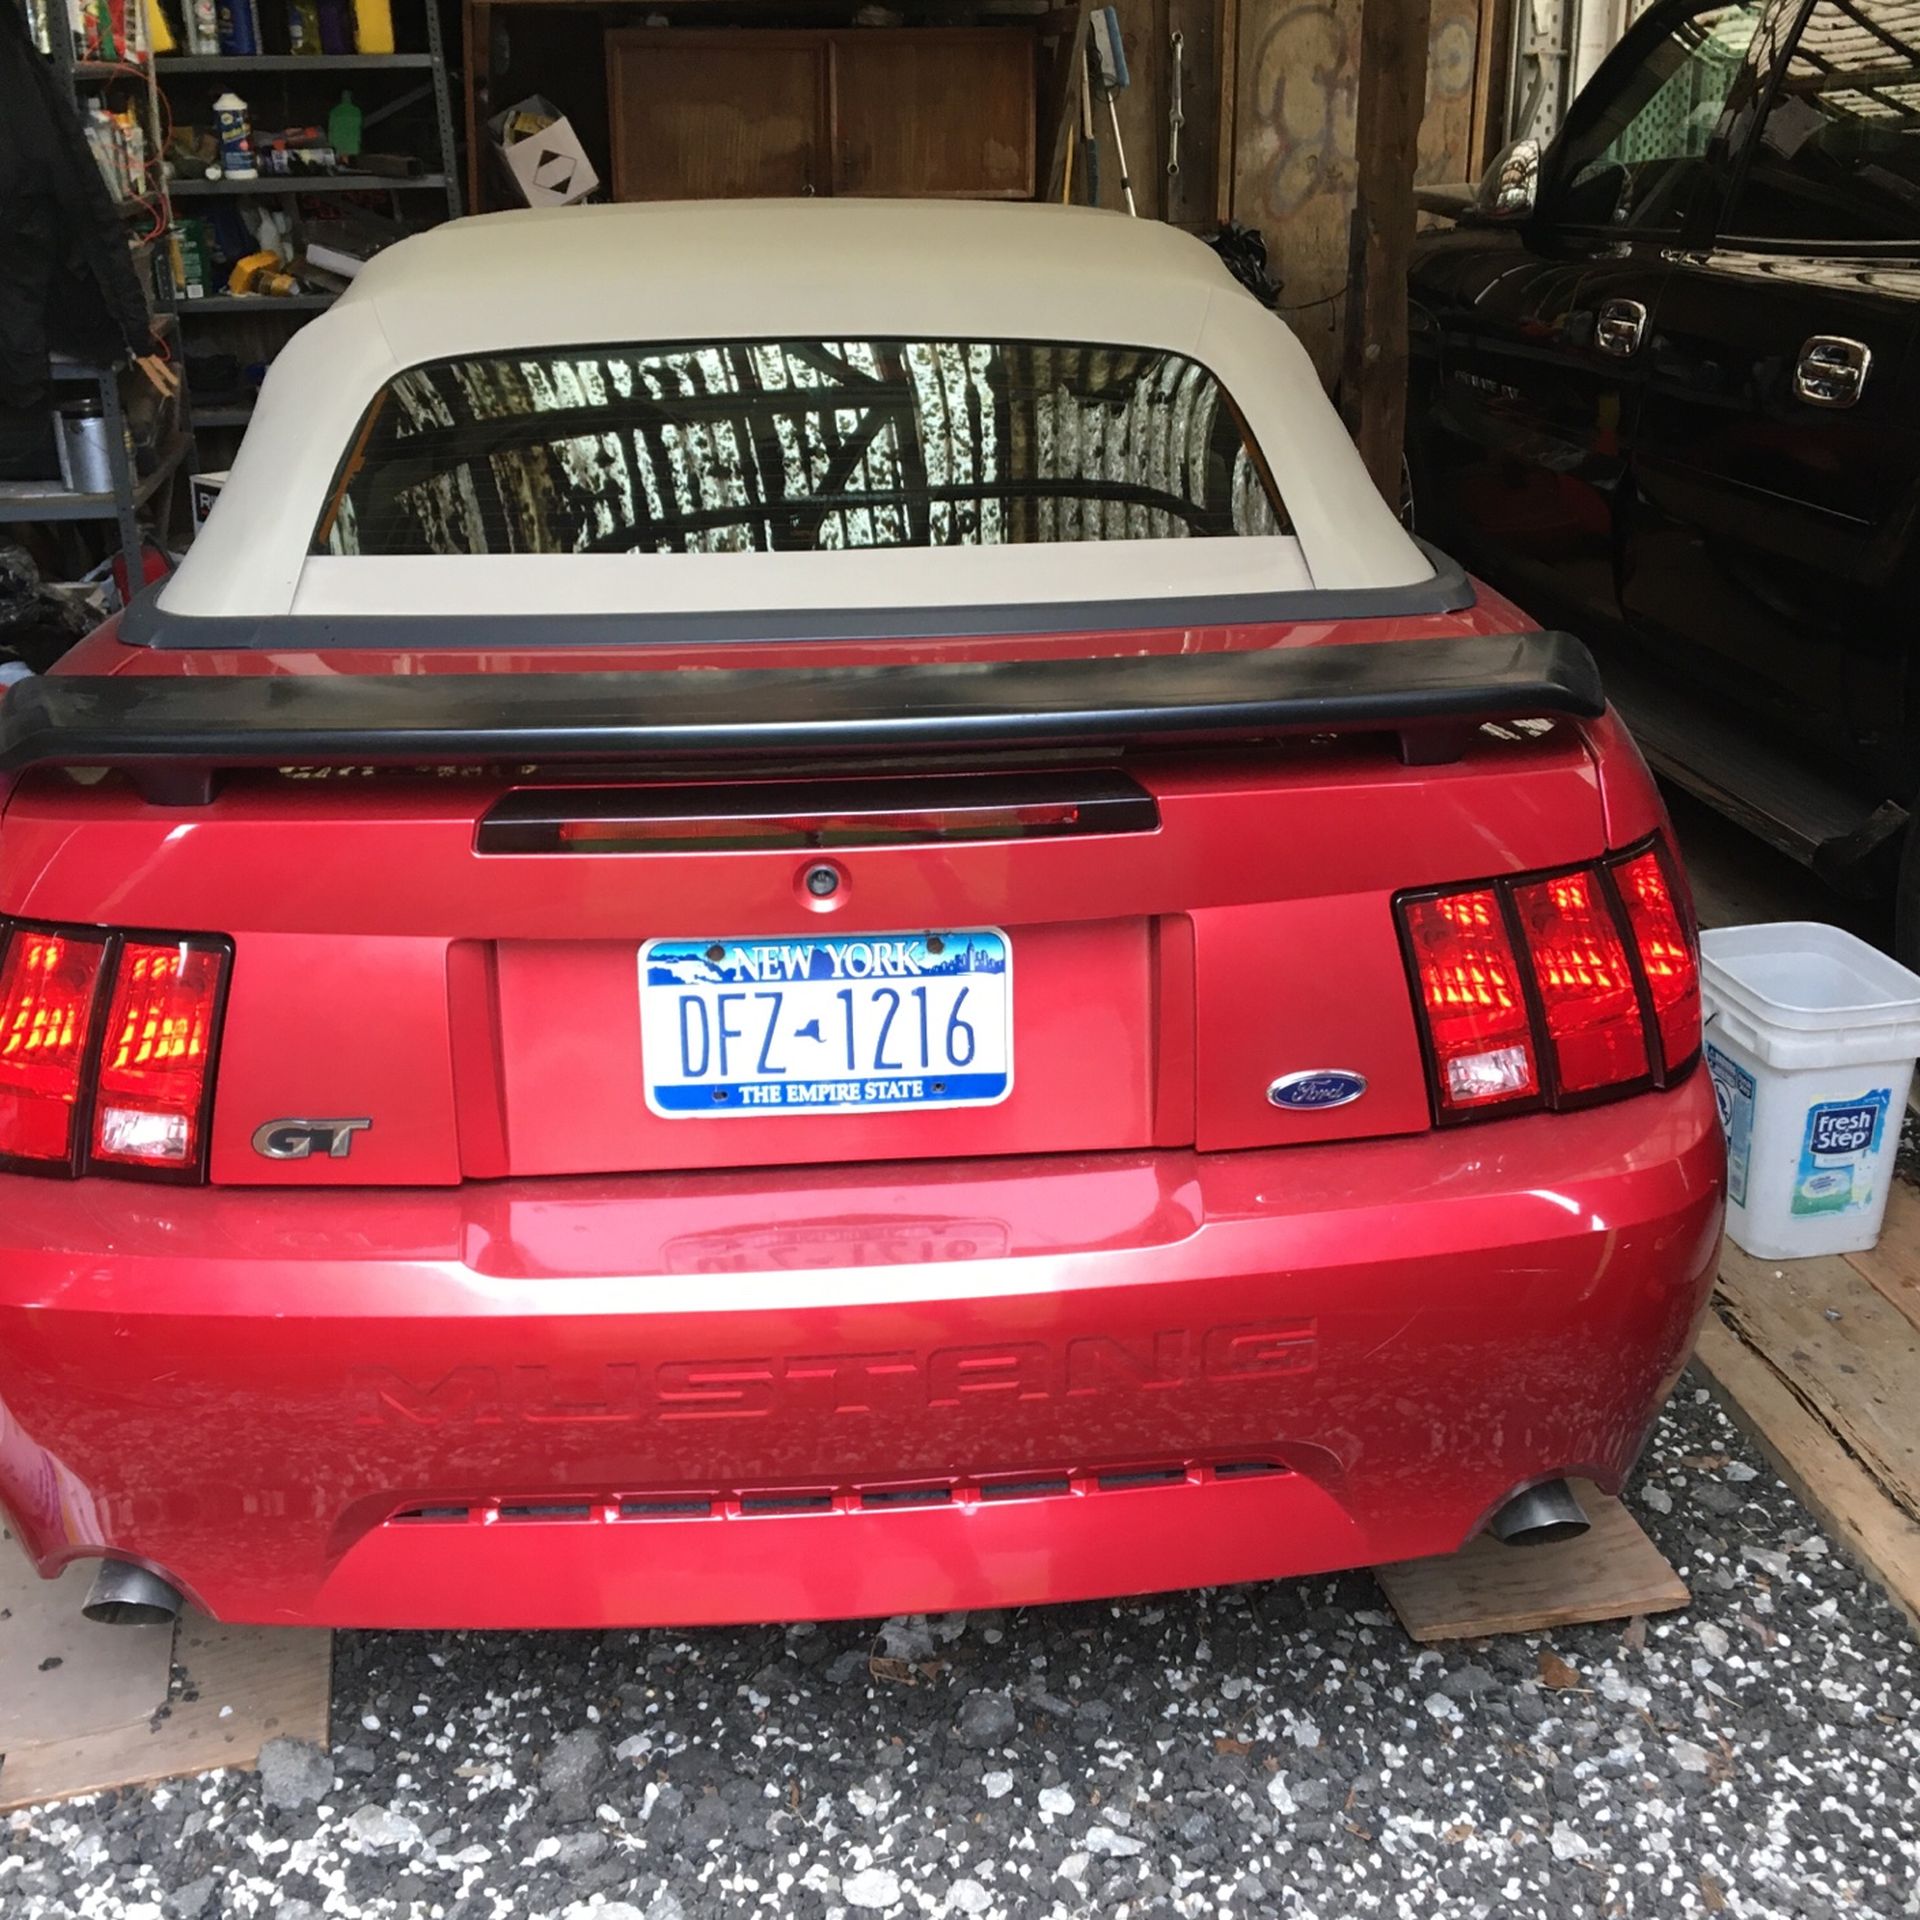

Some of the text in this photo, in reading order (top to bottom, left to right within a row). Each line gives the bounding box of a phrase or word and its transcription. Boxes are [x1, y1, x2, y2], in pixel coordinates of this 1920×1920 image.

[733, 941, 922, 981] NEW YORK
[739, 1080, 923, 1105] THE EMPIRE STATE
[1291, 1079, 1345, 1102] Ford
[251, 1118, 373, 1159] GT
[1817, 1131, 1866, 1149] Step
[349, 1316, 1318, 1425] MUSTANG
